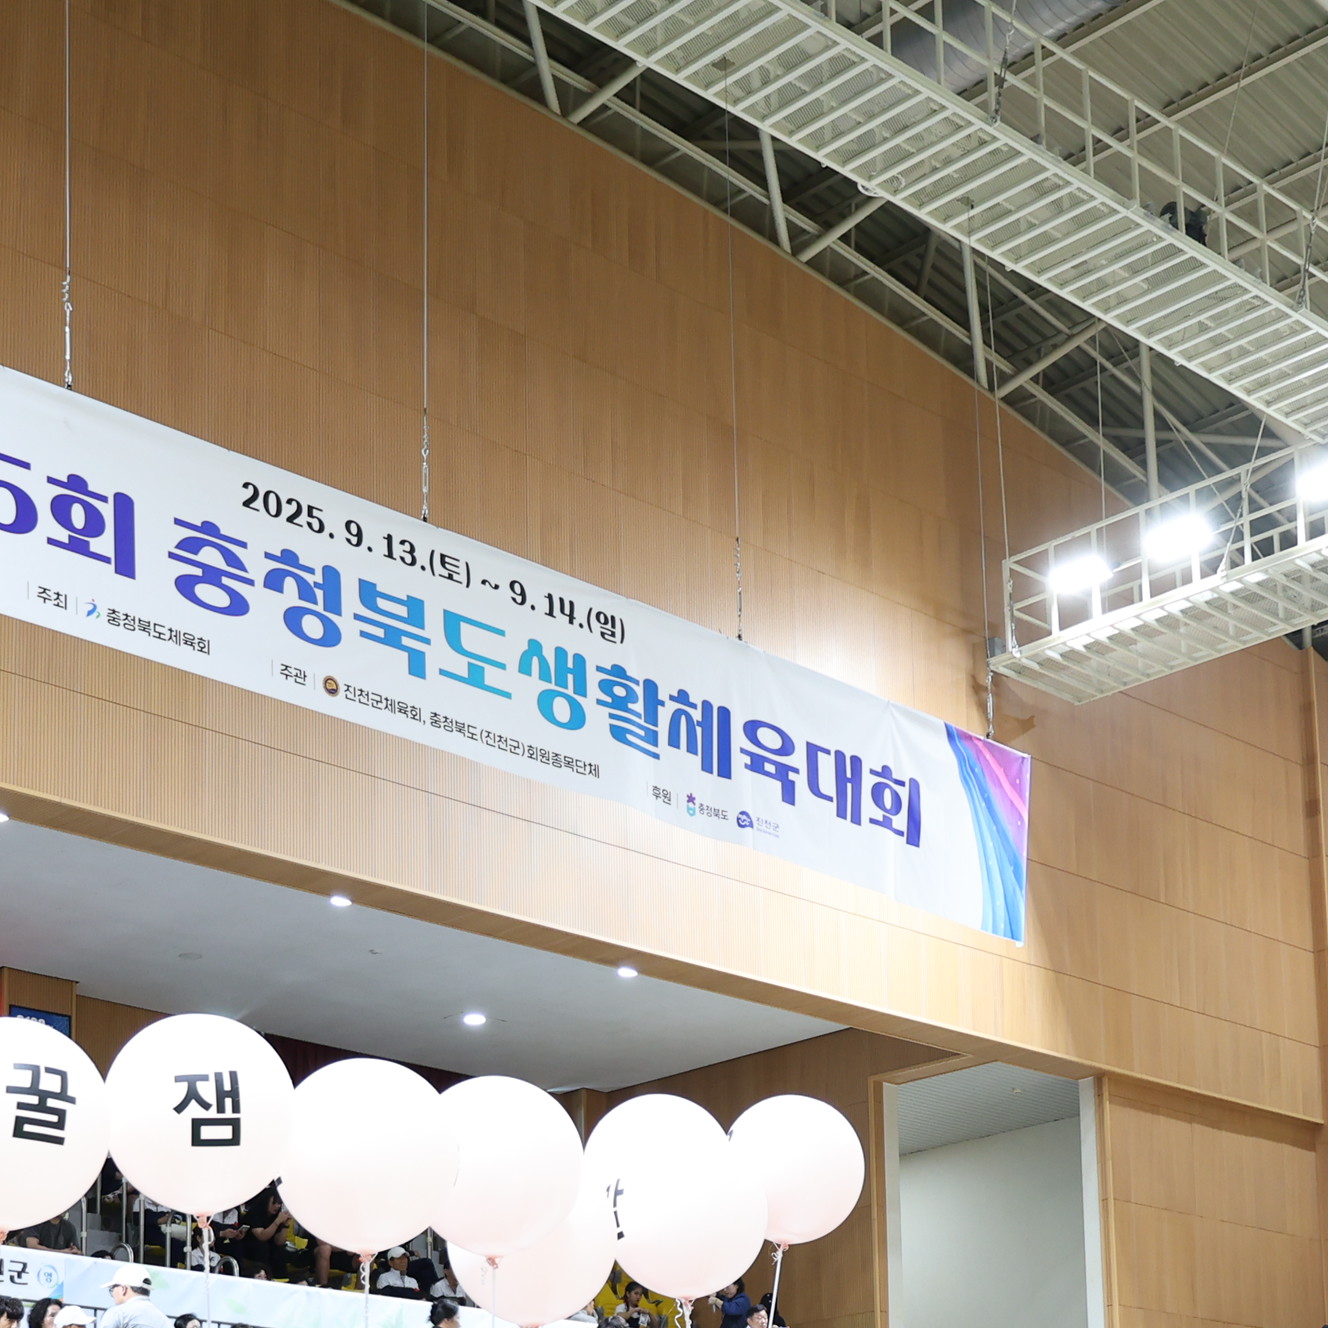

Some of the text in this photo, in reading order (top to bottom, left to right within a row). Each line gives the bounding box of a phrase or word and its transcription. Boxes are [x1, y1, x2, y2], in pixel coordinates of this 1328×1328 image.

[37, 585, 211, 655] 주최 충청북도체육회
[168, 516, 921, 848] 충청북도생활체육대회
[279, 663, 307, 686] 주관
[343, 683, 426, 725] 진천군체육회,
[652, 785, 729, 820] 후원 충청북도
[5, 1062, 77, 1147] 꿀
[172, 1069, 242, 1148] 잼
